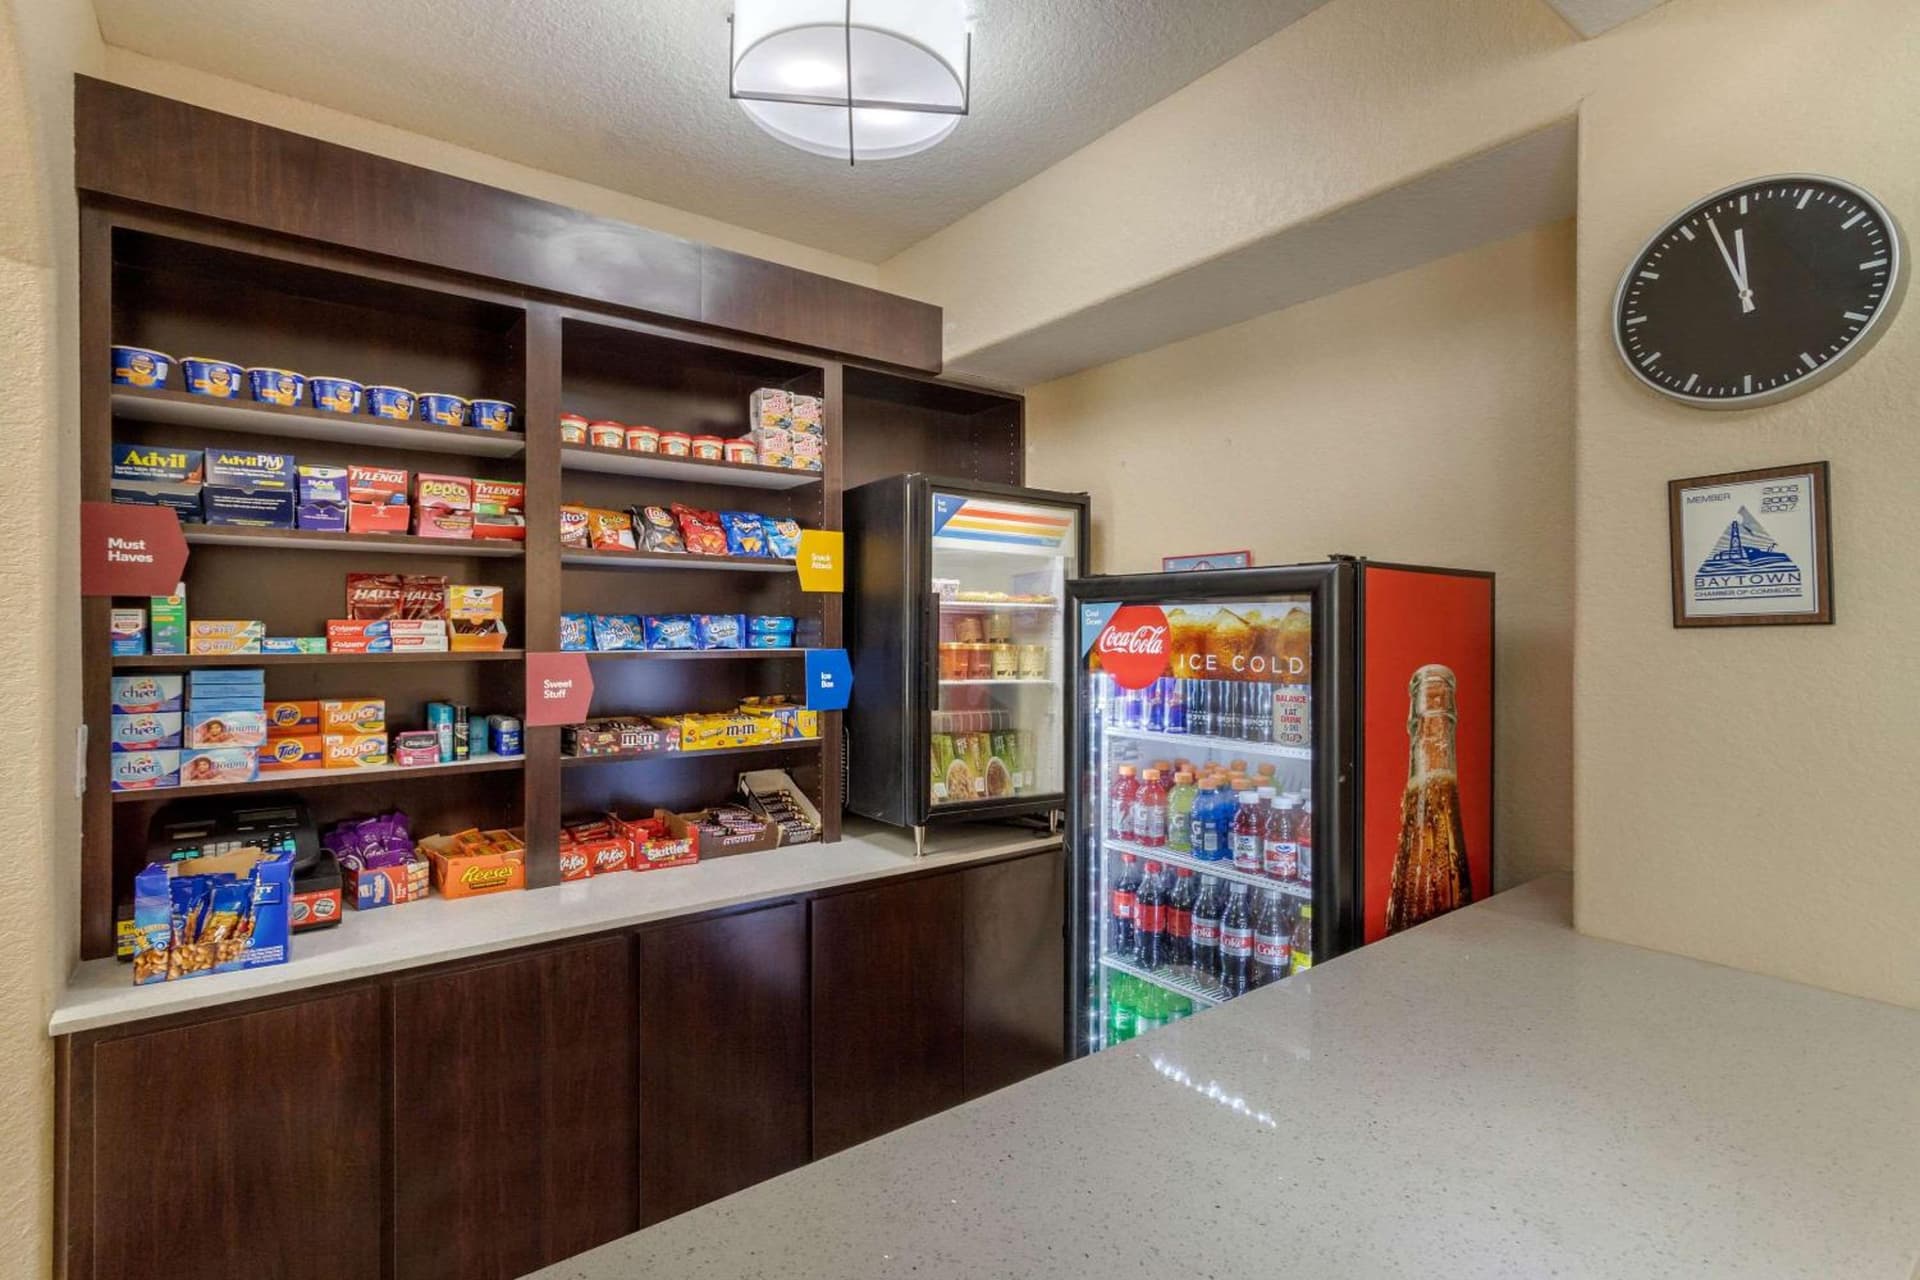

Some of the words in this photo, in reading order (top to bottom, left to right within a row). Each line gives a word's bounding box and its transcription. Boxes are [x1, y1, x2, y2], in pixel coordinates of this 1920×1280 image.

[123, 450, 186, 468] Advil
[218, 454, 257, 466] Advil
[350, 469, 404, 483] TYLENOL
[476, 482, 521, 496] TYLENOL
[1686, 493, 1731, 504] MEMBER
[107, 538, 146, 550] Must
[107, 551, 154, 563] Haves
[1694, 572, 1801, 588] BAYTOWN
[354, 588, 401, 600] HALLS
[403, 591, 443, 601] HALLS
[1694, 589, 1736, 598] CHAMBER
[1750, 587, 1801, 595] COMMERCE
[1179, 653, 1217, 671] ICE
[1232, 654, 1304, 675] COLD
[121, 684, 158, 699] cheer
[543, 680, 573, 689] Sweet
[543, 689, 567, 699] Stuff
[1275, 694, 1307, 703] BALANCE
[275, 708, 299, 721] Tide
[329, 707, 376, 724] bounce
[121, 720, 160, 736] cheer
[277, 744, 301, 758] Tide
[331, 740, 378, 758] bounce
[119, 759, 159, 775] cheer
[646, 843, 690, 861] Skittles
[1257, 943, 1285, 957] Coke
